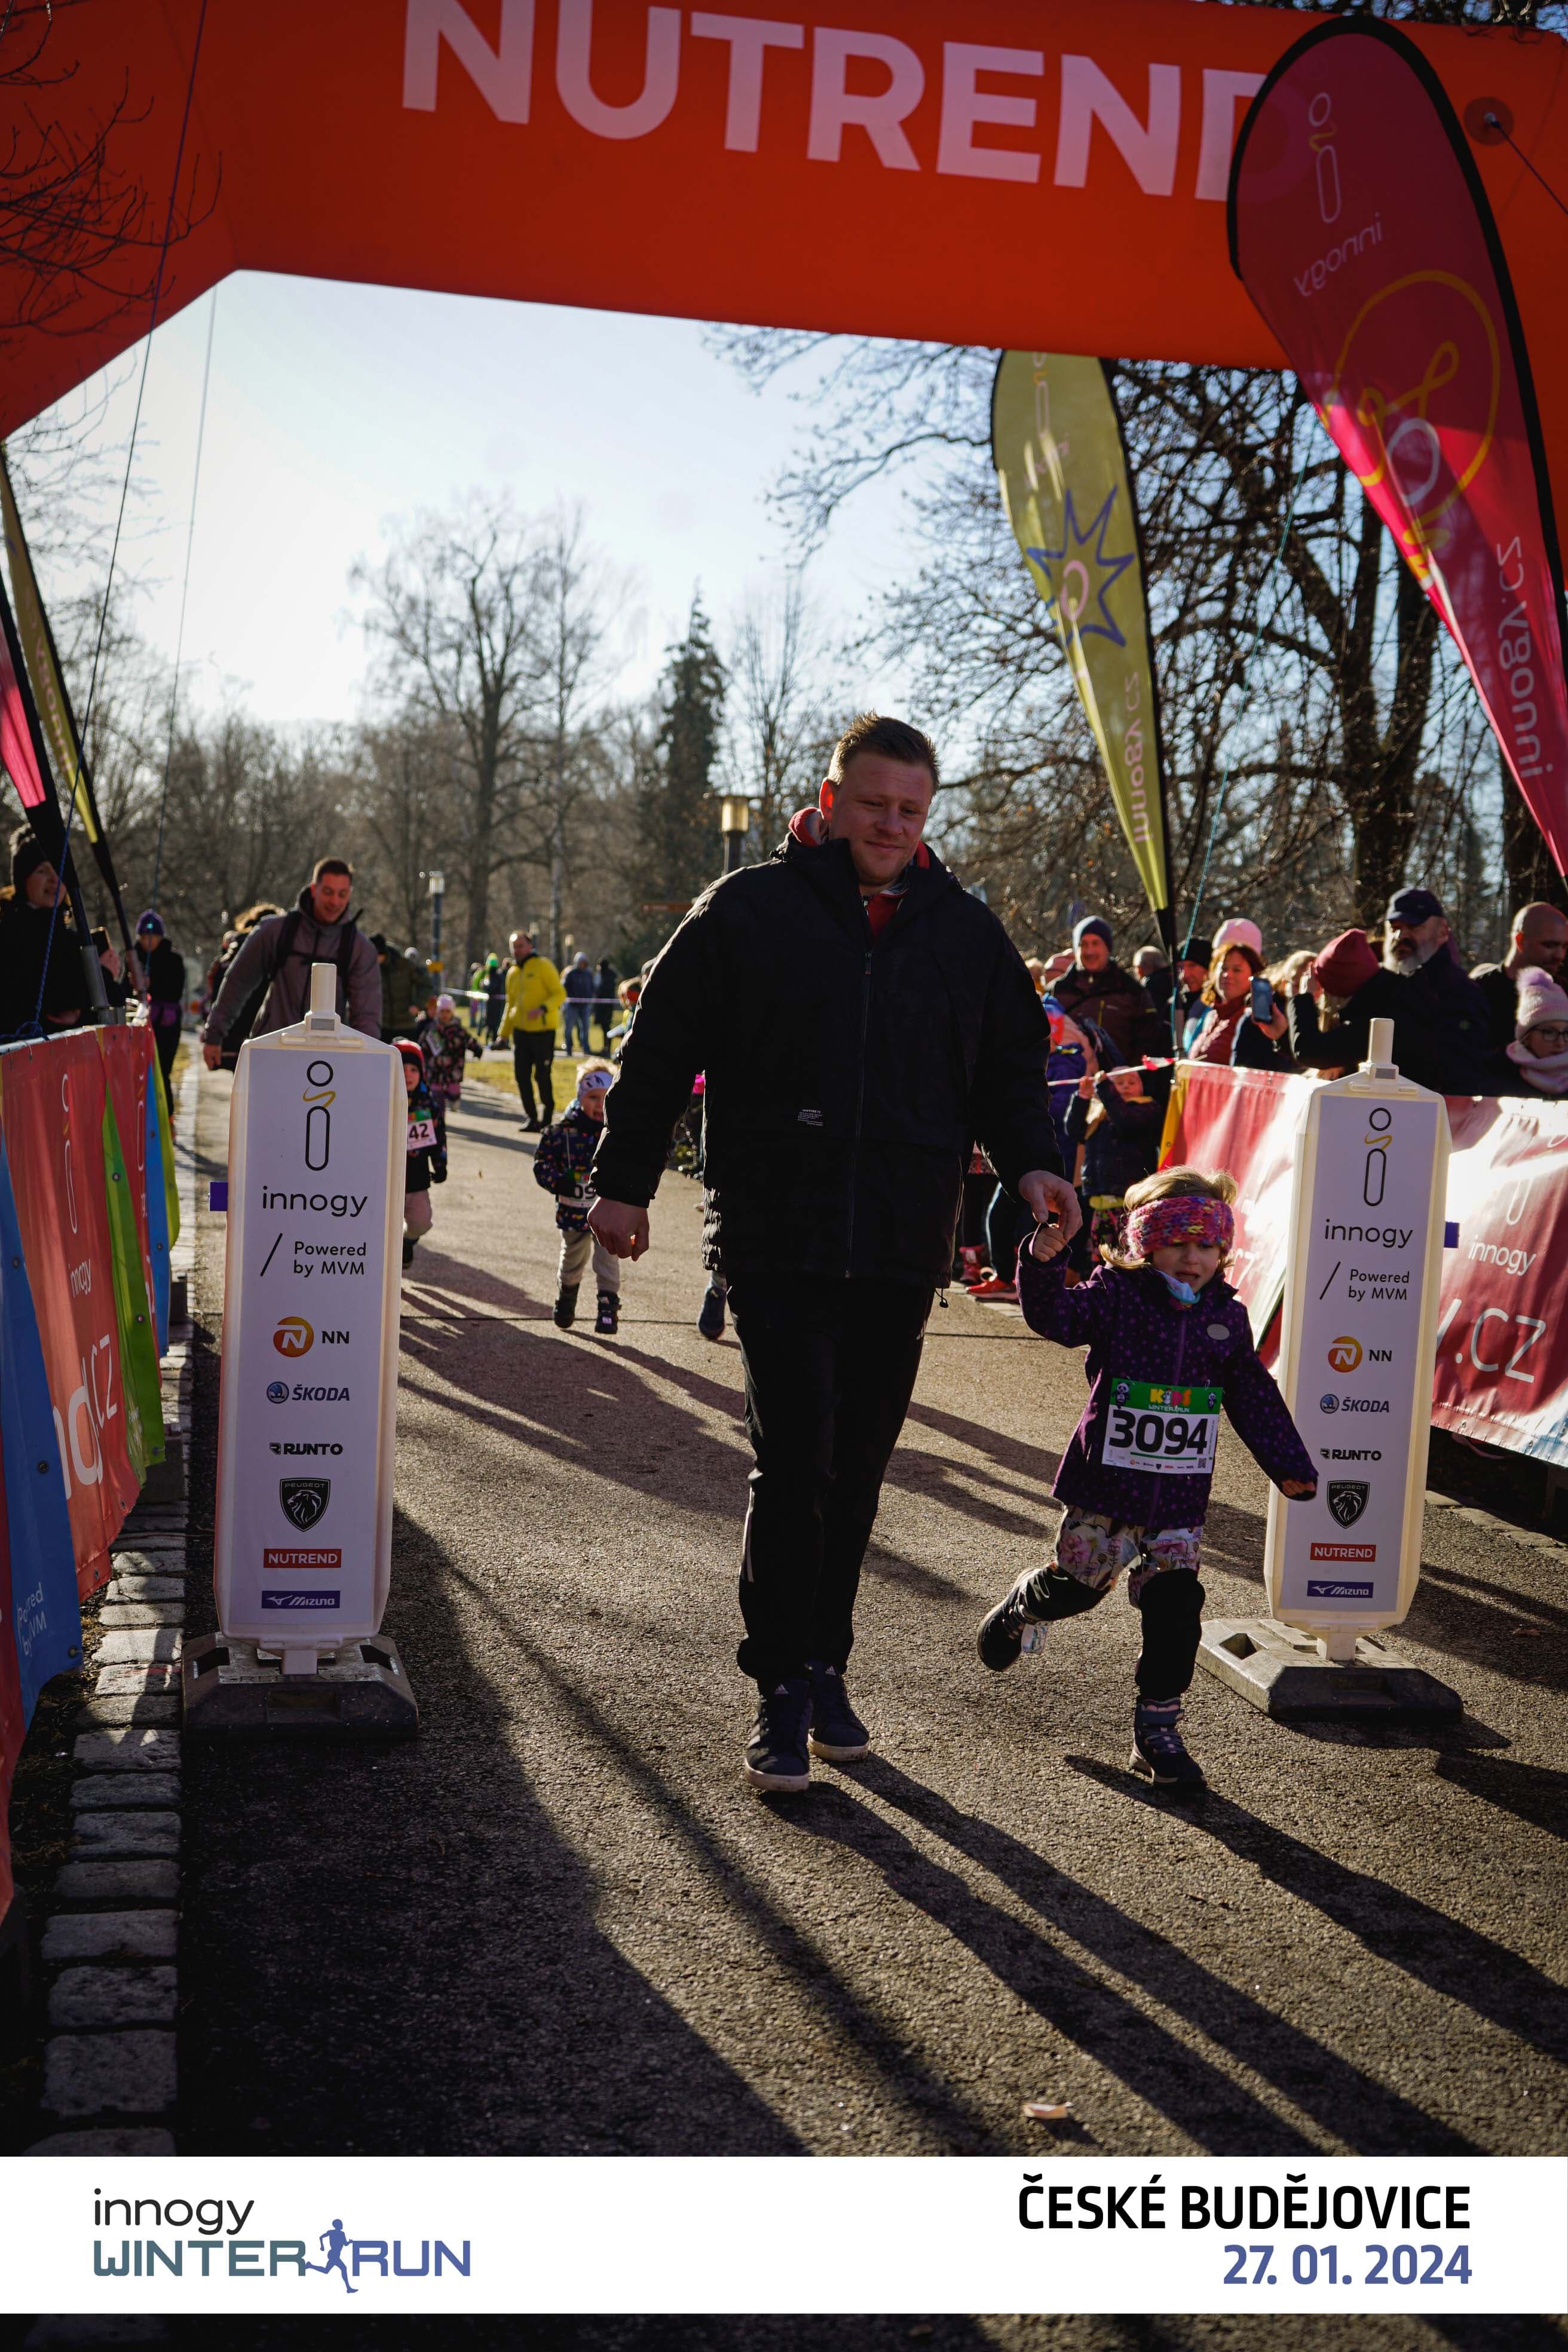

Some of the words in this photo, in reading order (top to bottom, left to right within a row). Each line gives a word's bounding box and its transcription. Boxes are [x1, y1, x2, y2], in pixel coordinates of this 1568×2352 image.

[262, 1186, 368, 1217] innogy
[1324, 1218, 1413, 1248] innogy
[294, 1241, 367, 1257] Powered
[1468, 1235, 1537, 1276] innogy
[293, 1260, 314, 1278] by
[321, 1261, 365, 1275] MVM
[1350, 1269, 1410, 1284] Powered
[1348, 1285, 1366, 1301] by
[1371, 1288, 1407, 1301] MVM
[321, 1330, 350, 1345] NN
[1368, 1349, 1392, 1362] NN
[292, 1385, 350, 1401] ŠKODA
[1341, 1396, 1390, 1413] ŠKODA
[1108, 1409, 1208, 1455] 3094
[283, 1443, 343, 1456] RUNTO
[1332, 1449, 1382, 1461] RUNTO
[268, 1553, 338, 1564] NUTREND
[1314, 1546, 1373, 1558] NUTREND
